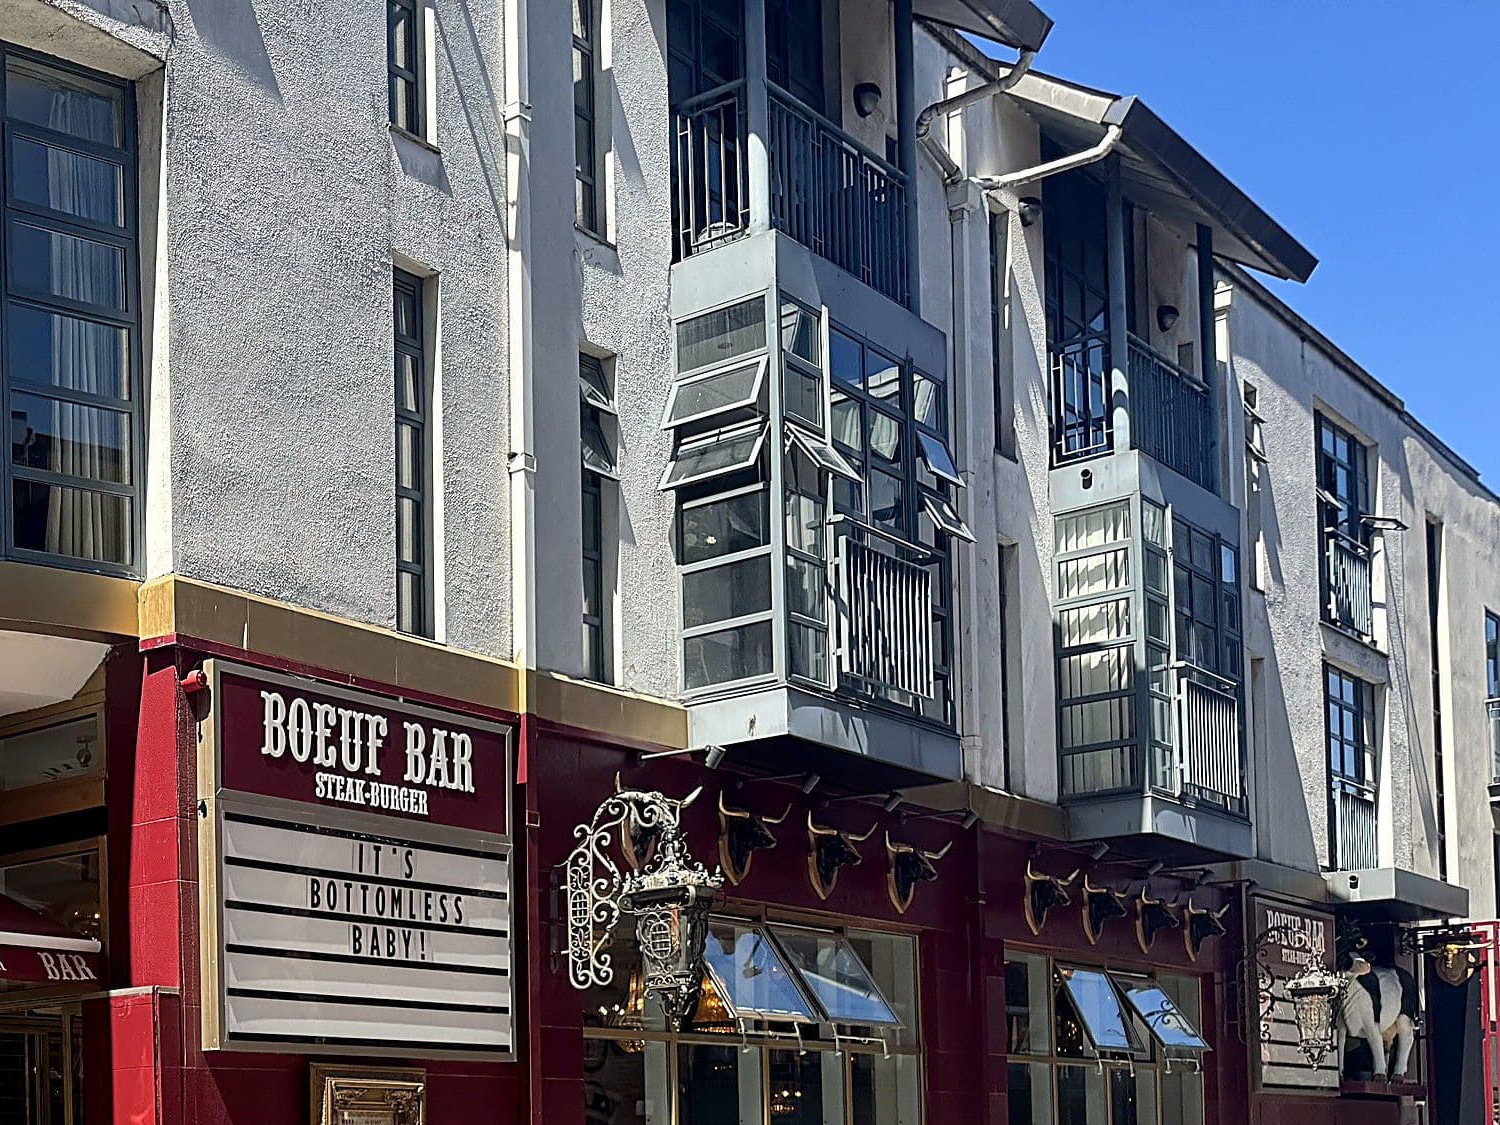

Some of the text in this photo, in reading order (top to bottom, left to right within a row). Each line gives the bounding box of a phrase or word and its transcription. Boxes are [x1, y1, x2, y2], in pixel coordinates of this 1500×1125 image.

[260, 690, 476, 793] BOEUF BAR
[357, 843, 414, 880] IT'S
[309, 878, 464, 925] BOTTOMLESS
[352, 924, 426, 961] BABY!
[1304, 918, 1326, 953] BAR
[37, 951, 97, 981] BAR
